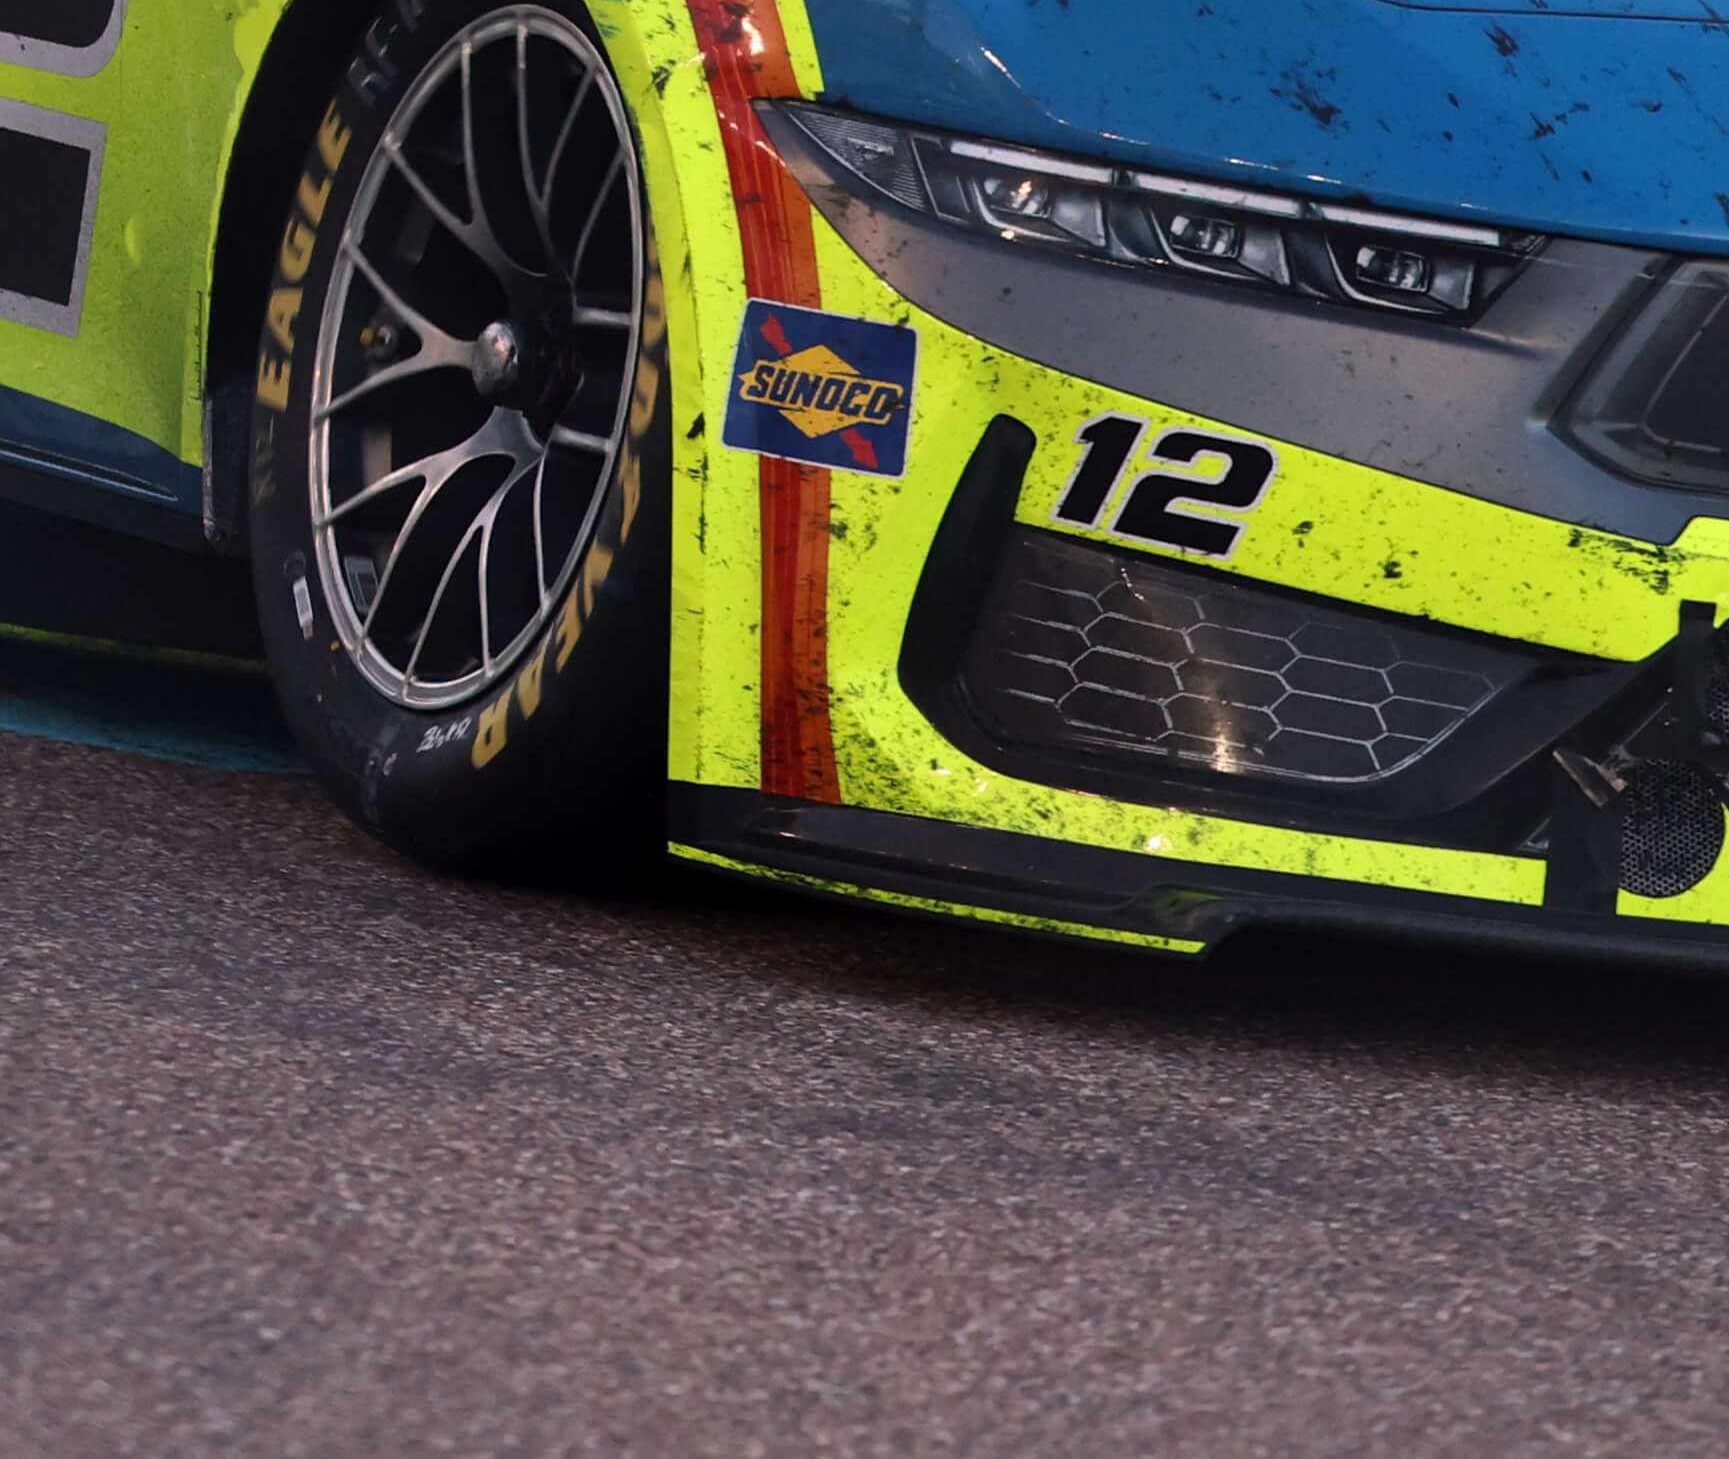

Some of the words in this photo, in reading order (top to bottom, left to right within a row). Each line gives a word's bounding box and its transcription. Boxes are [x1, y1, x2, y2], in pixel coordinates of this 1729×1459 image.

[256, 97, 353, 414] EAGLE
[746, 364, 900, 421] SUNOCO
[1051, 411, 1278, 559] 12
